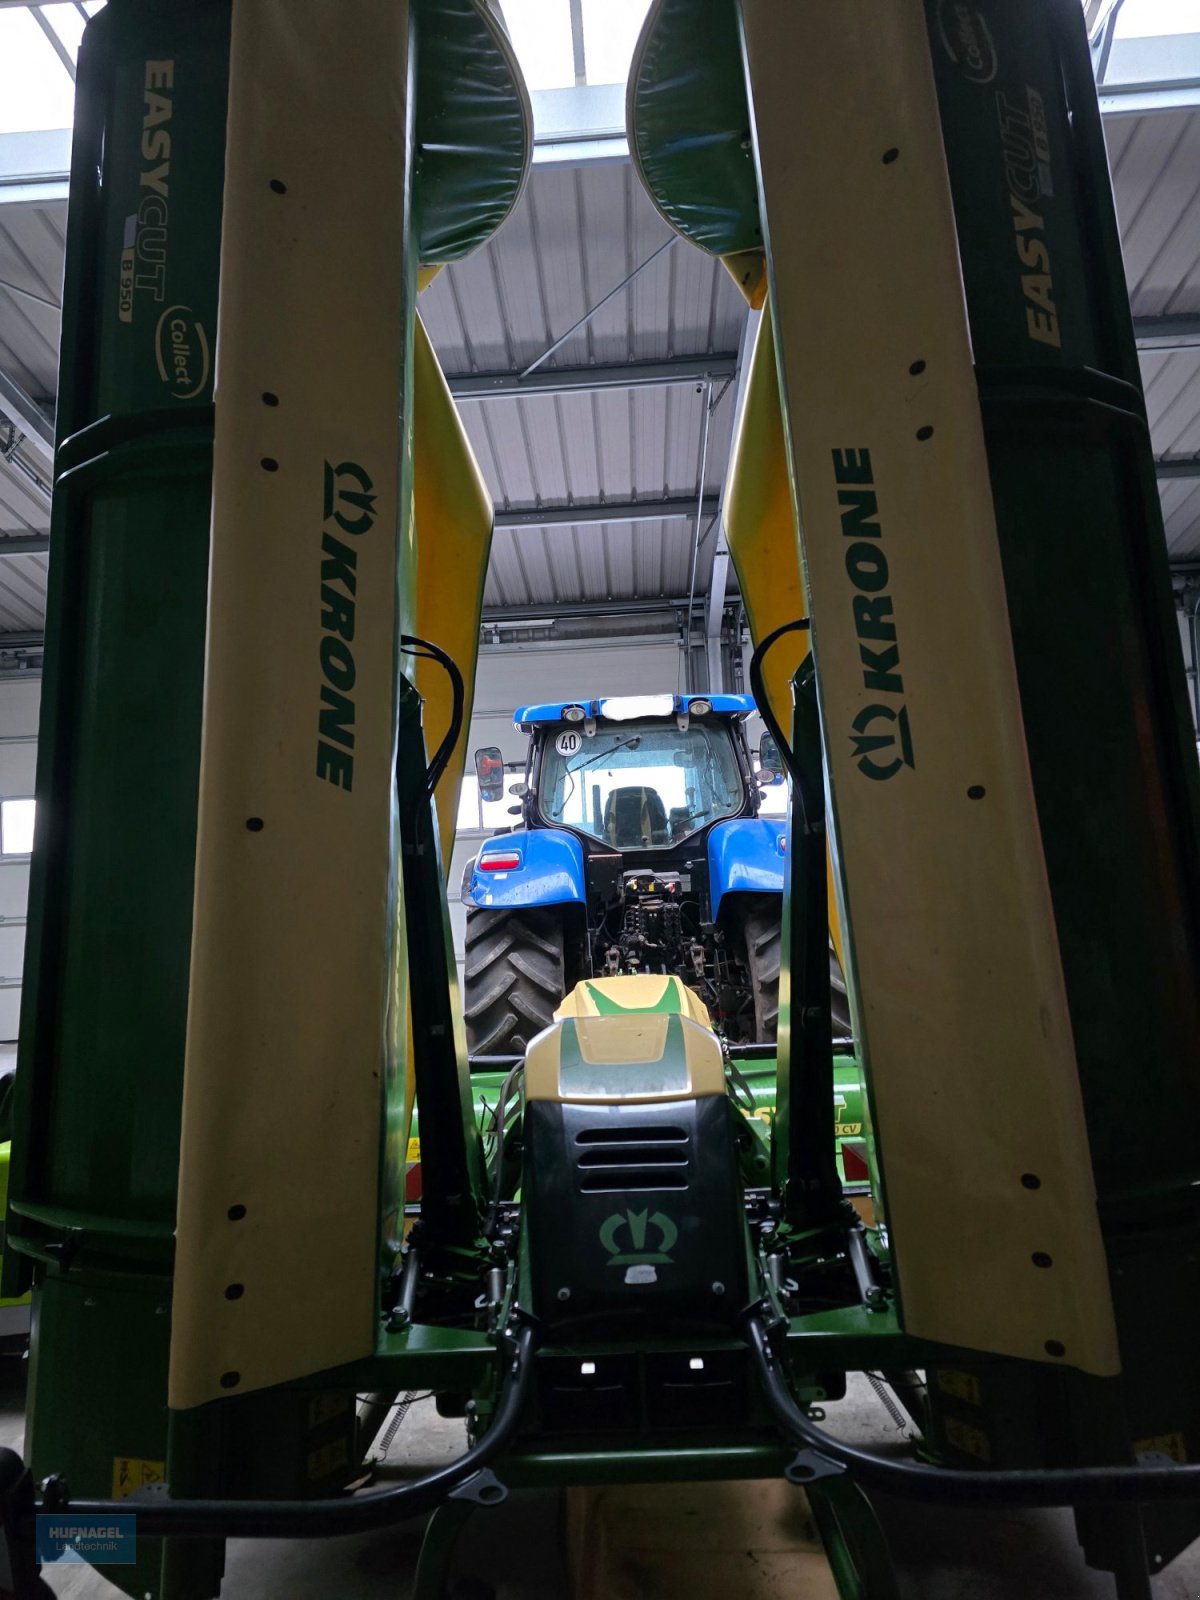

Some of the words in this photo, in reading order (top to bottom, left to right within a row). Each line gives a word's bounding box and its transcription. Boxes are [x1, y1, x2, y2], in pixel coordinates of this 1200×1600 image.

[135, 60, 175, 302] EASYCUT
[996, 92, 1061, 348] EASYCUT
[119, 278, 132, 313] 950
[121, 259, 133, 271] B
[170, 318, 192, 385] Collect
[832, 448, 904, 693] KRONE
[318, 532, 358, 792] KRONE
[561, 734, 577, 750] 40
